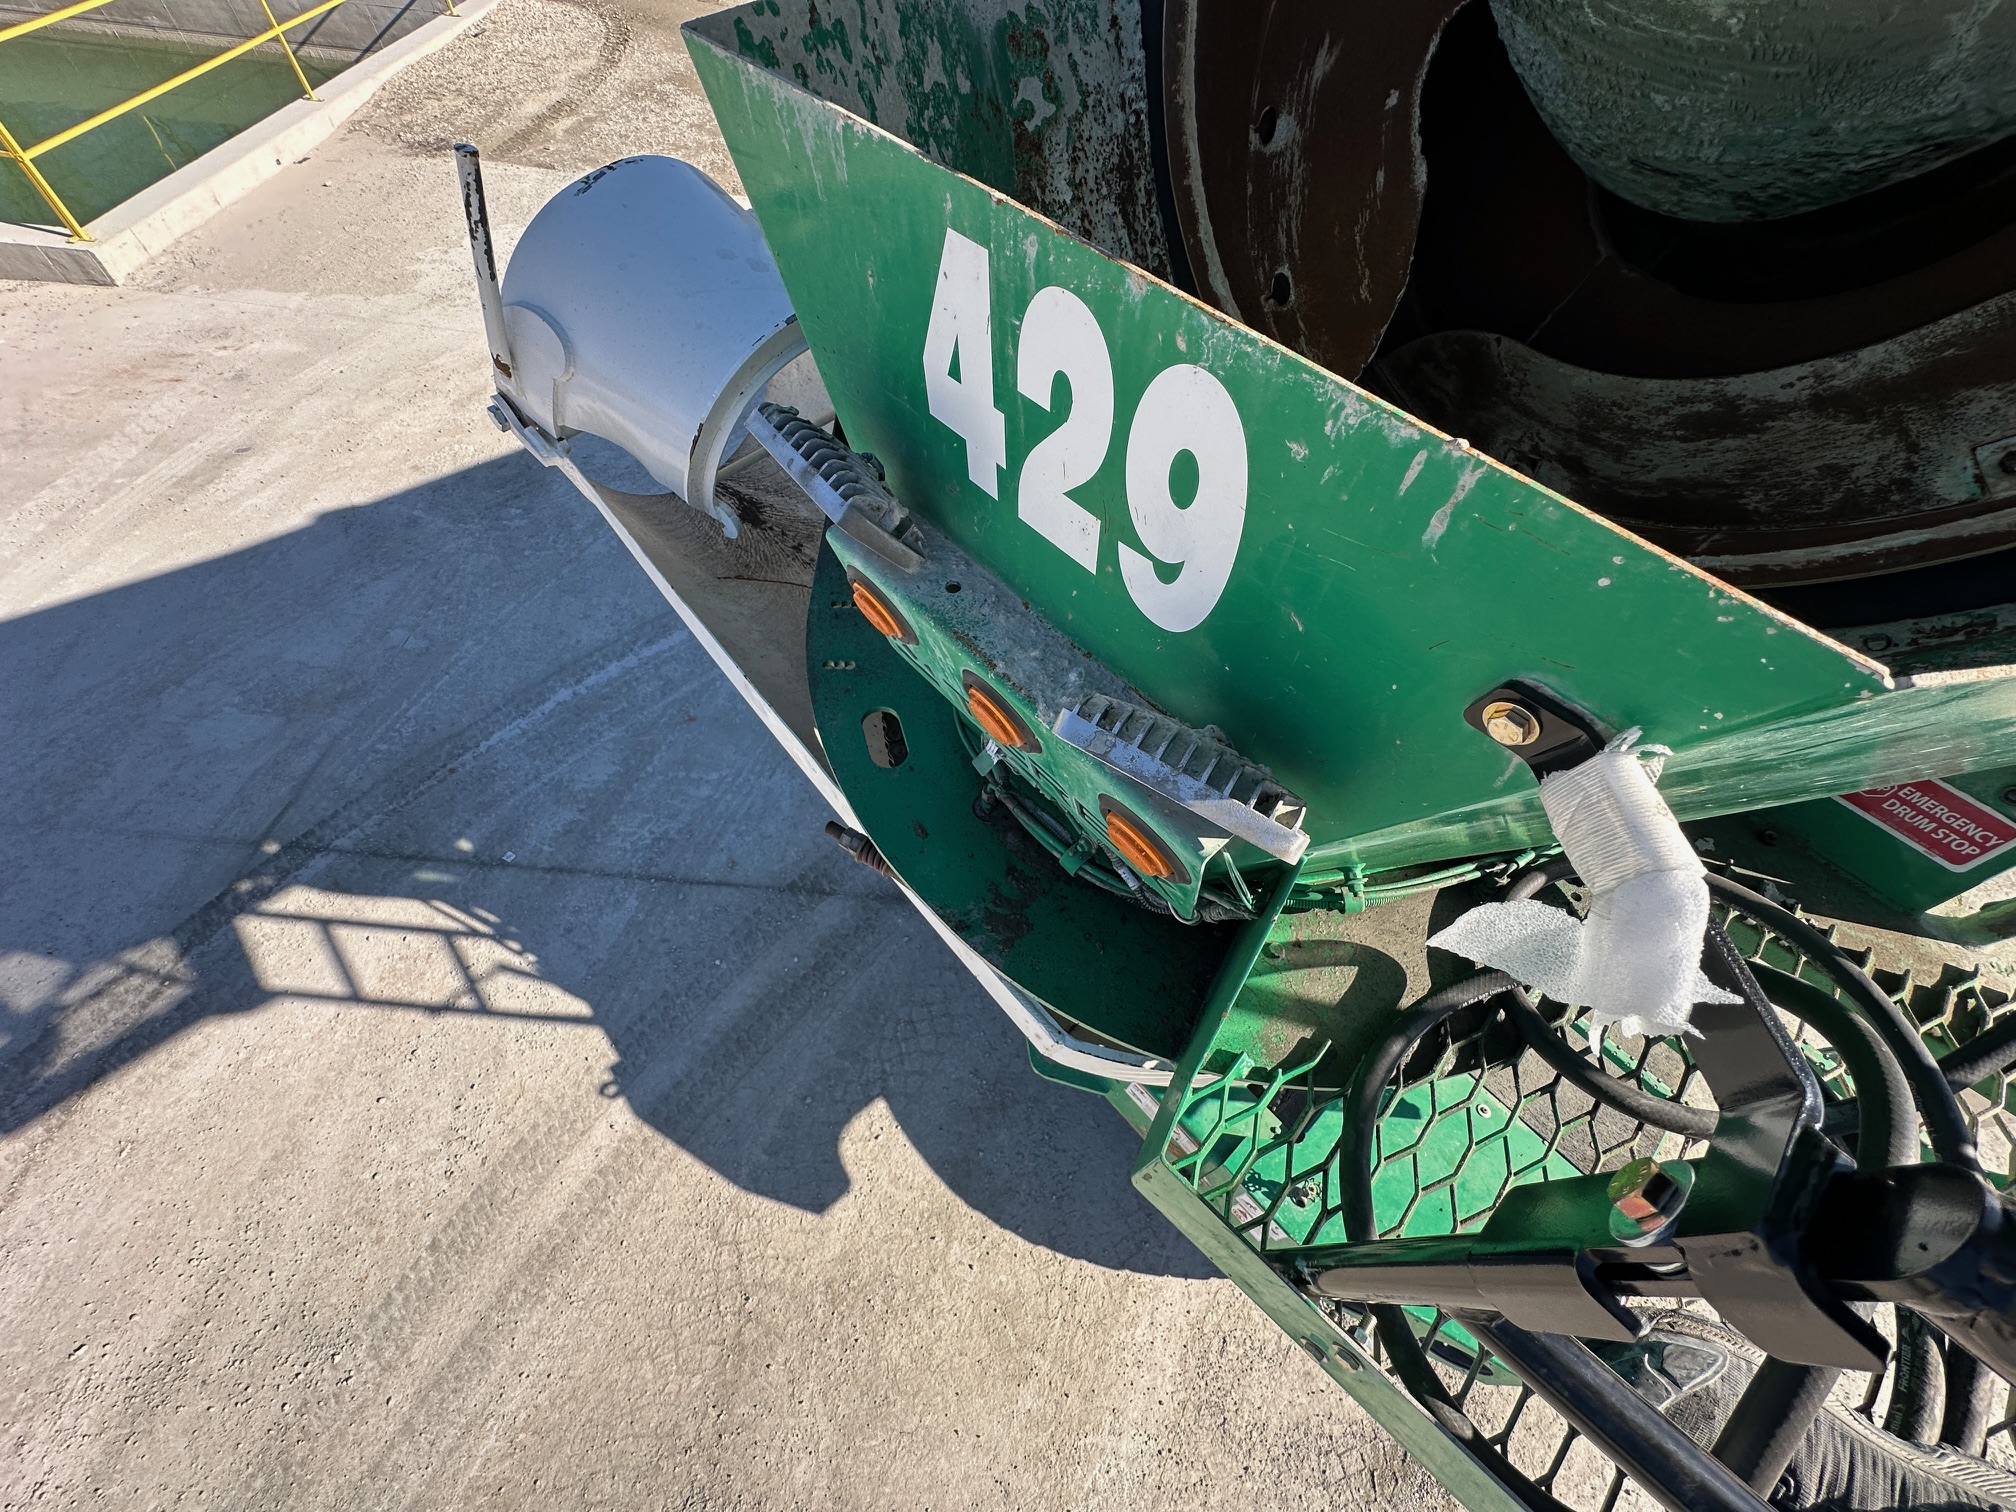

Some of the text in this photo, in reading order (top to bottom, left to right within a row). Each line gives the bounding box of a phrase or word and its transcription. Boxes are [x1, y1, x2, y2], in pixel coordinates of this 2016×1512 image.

[923, 227, 1248, 632] 429
[1882, 798, 1936, 833] DRUM
[1931, 828, 1981, 856] STOP
[1897, 786, 2006, 848] EMERGENCY
[1898, 1344, 1912, 1393] FRONTIER
